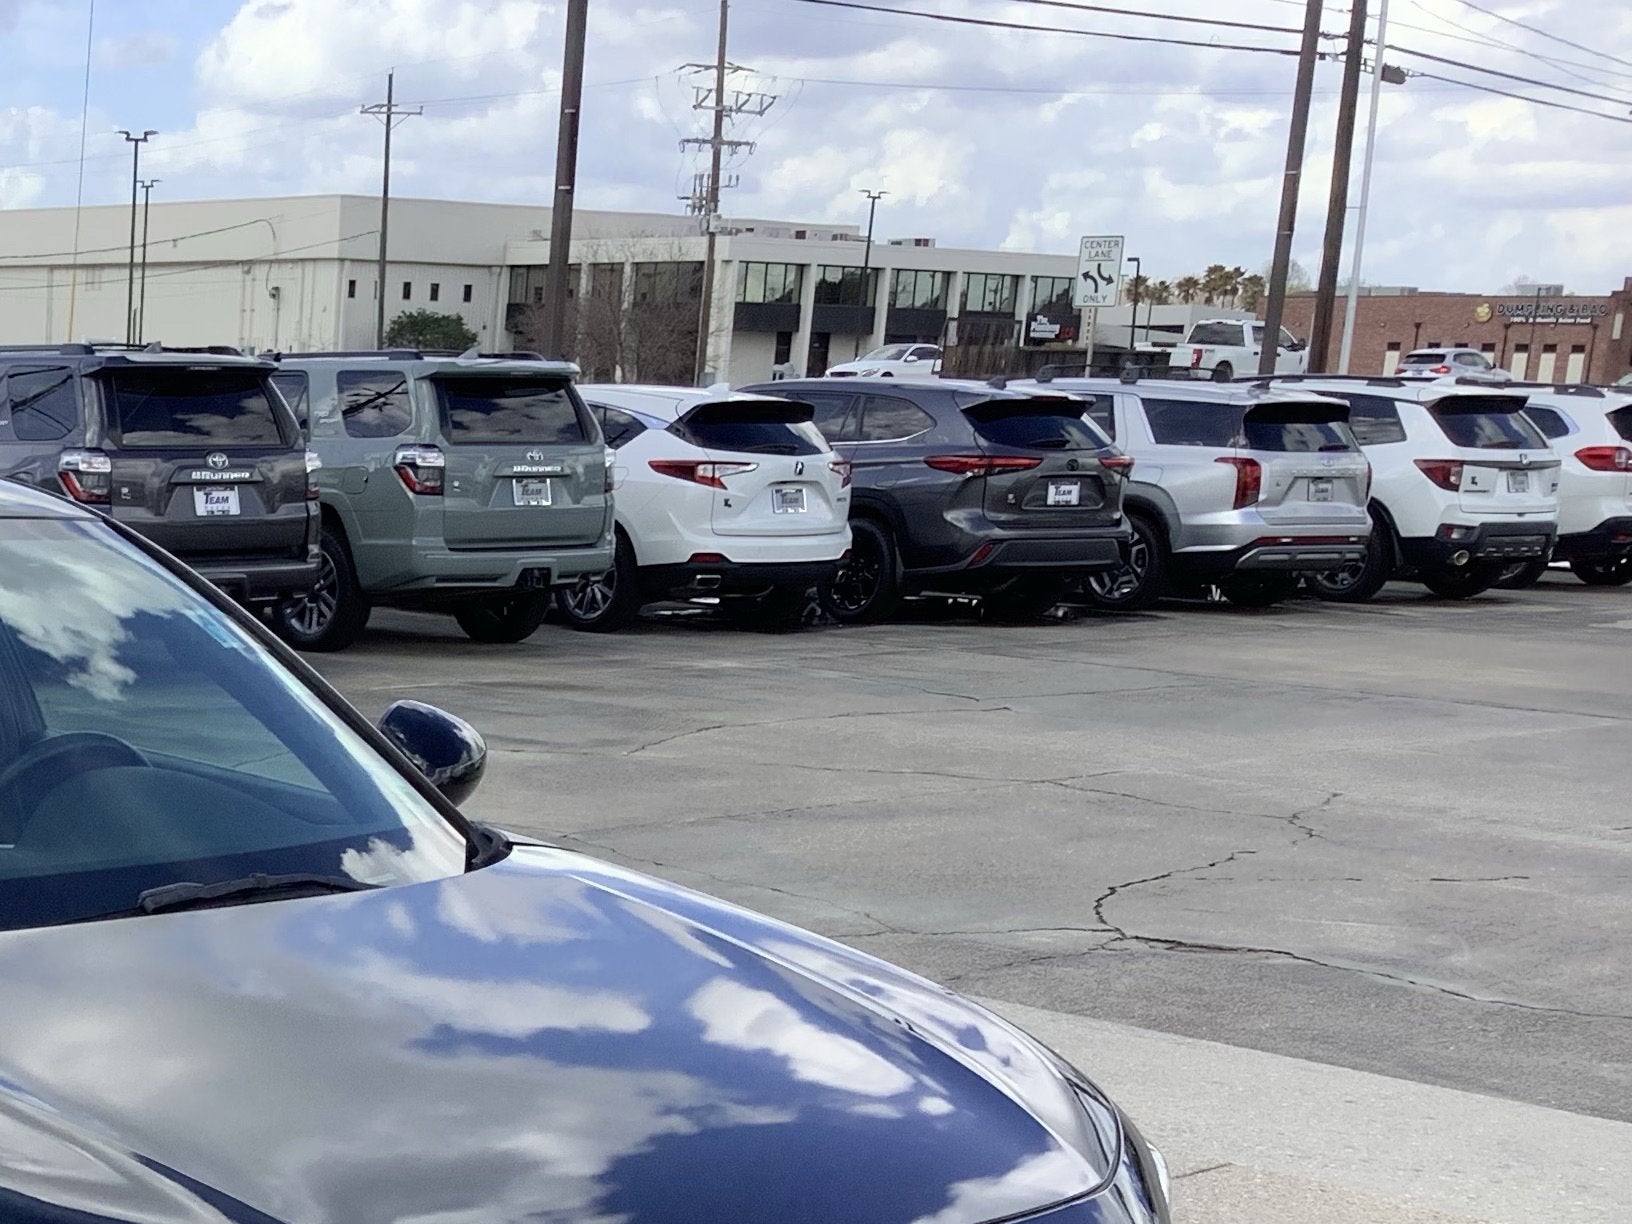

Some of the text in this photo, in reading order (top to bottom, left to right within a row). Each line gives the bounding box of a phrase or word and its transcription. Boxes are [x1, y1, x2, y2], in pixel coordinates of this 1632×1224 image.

[1084, 240, 1119, 249] CENTER
[1089, 250, 1112, 258] LANE
[1083, 294, 1107, 304] ONLY
[1497, 303, 1563, 315] DUMPING
[203, 492, 229, 505] TEAM
